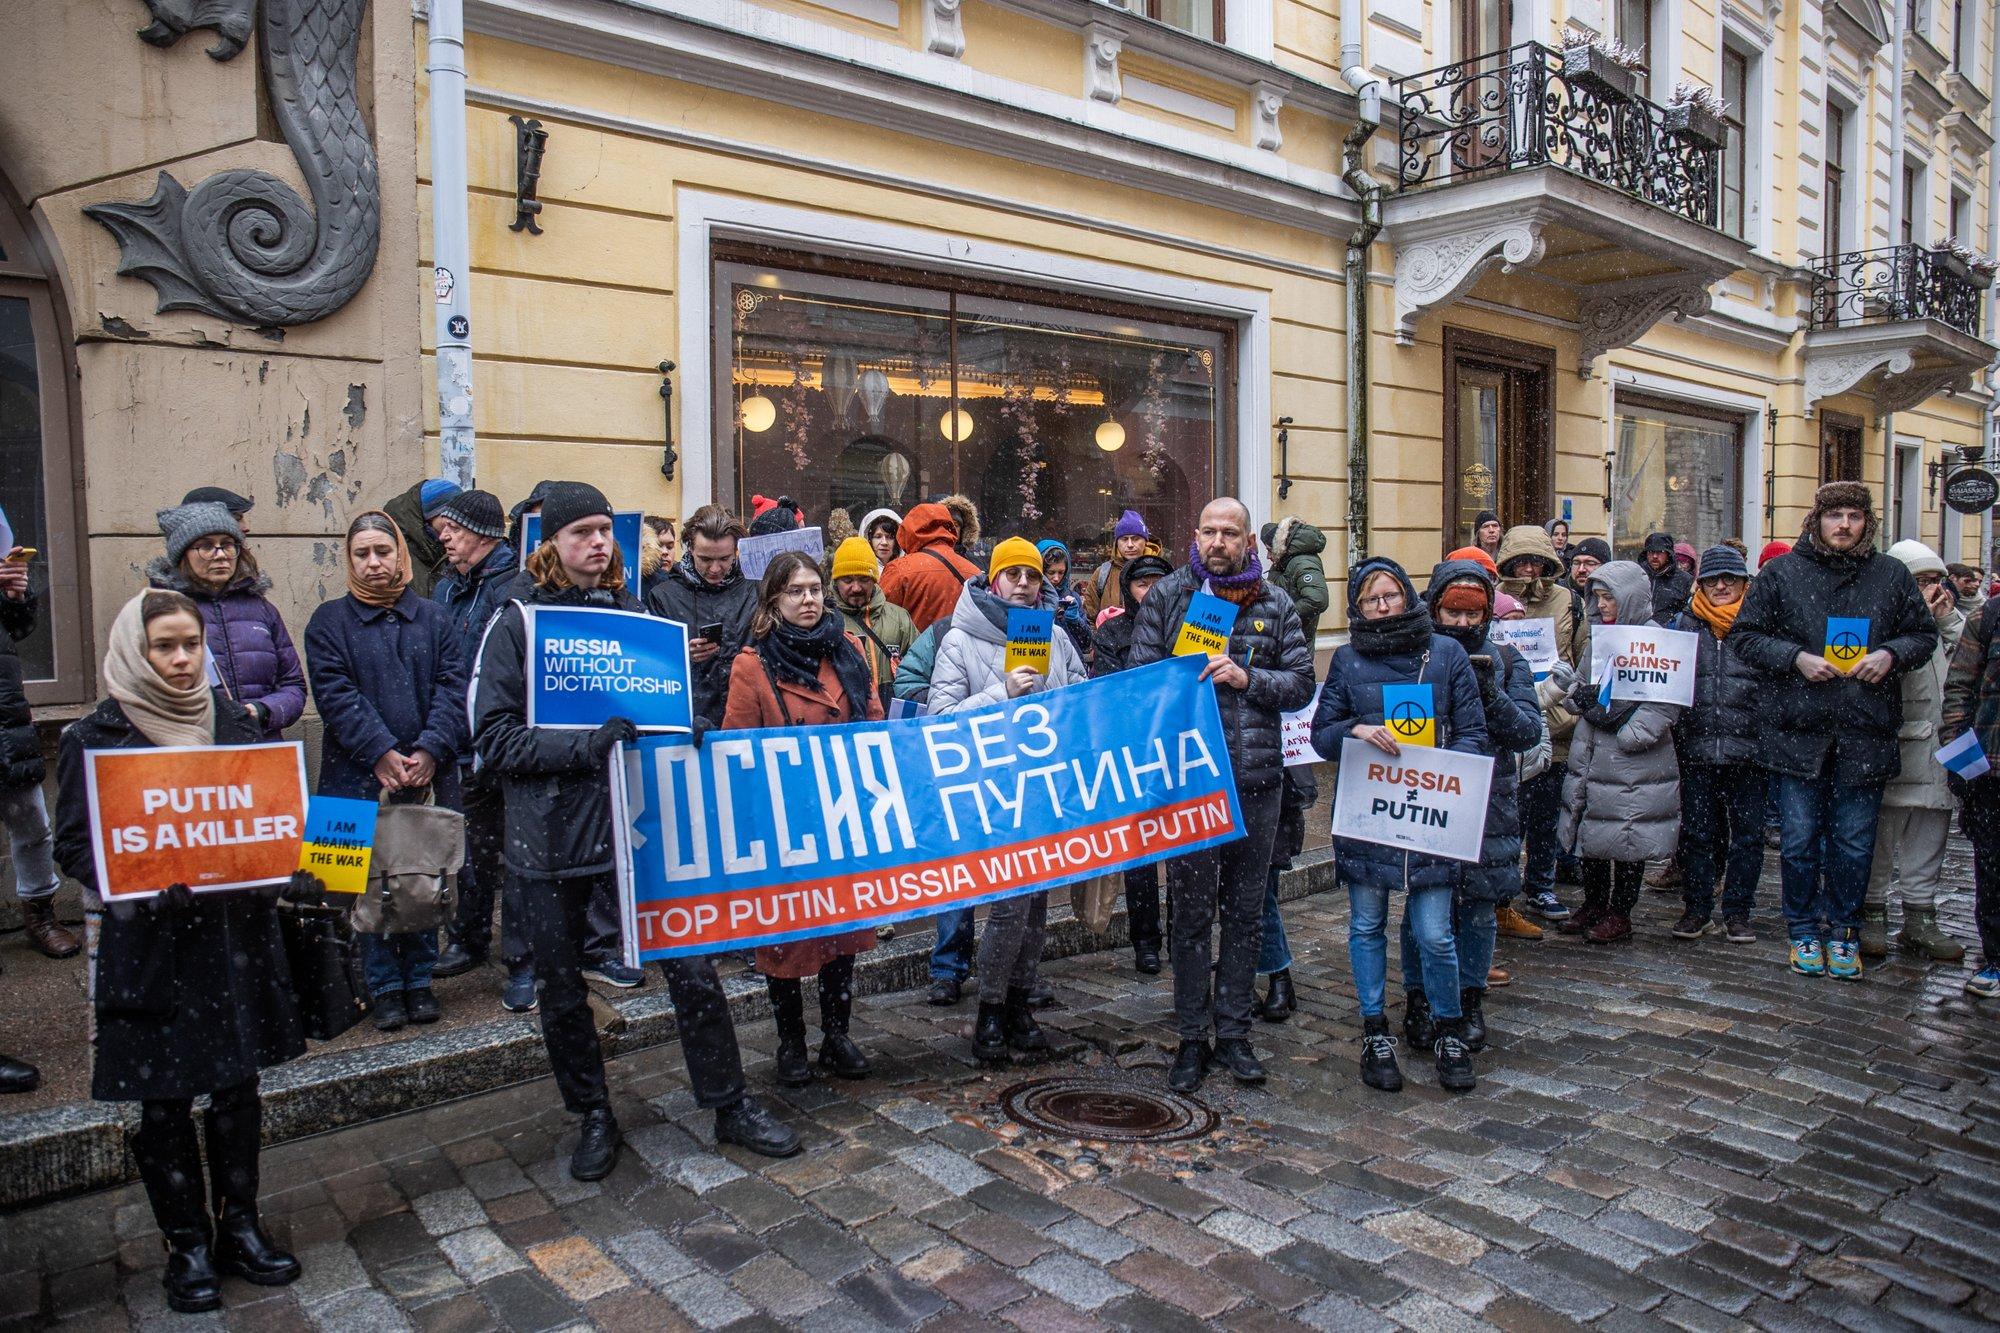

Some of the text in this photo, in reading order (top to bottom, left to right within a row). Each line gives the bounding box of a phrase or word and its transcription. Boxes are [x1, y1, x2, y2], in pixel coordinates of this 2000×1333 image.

[1201, 610, 1222, 624] I AM
[1026, 625, 1040, 633] AM
[1189, 620, 1225, 638] AGAINST
[544, 638, 622, 656] RUSSIA
[1012, 636, 1047, 645] AGAINST
[1186, 631, 1221, 650] THE WAR
[1012, 648, 1047, 657] THE WAR
[544, 657, 636, 674] WITHOUT
[1613, 655, 1681, 672] GAINST
[544, 675, 682, 695] DICTATORSHIP
[1618, 669, 1668, 684] PUTIN
[1297, 721, 1311, 729] ПРЕ
[921, 703, 1058, 778] БЕЗ
[938, 728, 1220, 842] ПУТИНА
[1367, 763, 1461, 795] RUSSIA
[143, 784, 253, 815] PUTIN
[1371, 797, 1448, 828] PUTIN
[111, 815, 298, 854] IS A KILLER
[327, 821, 356, 833] I AM
[312, 836, 366, 851] AGAINST
[310, 852, 363, 867] THE WAR
[637, 798, 1230, 941] TOP PUTIN. RUSSIA WITHOUT PUTIN
